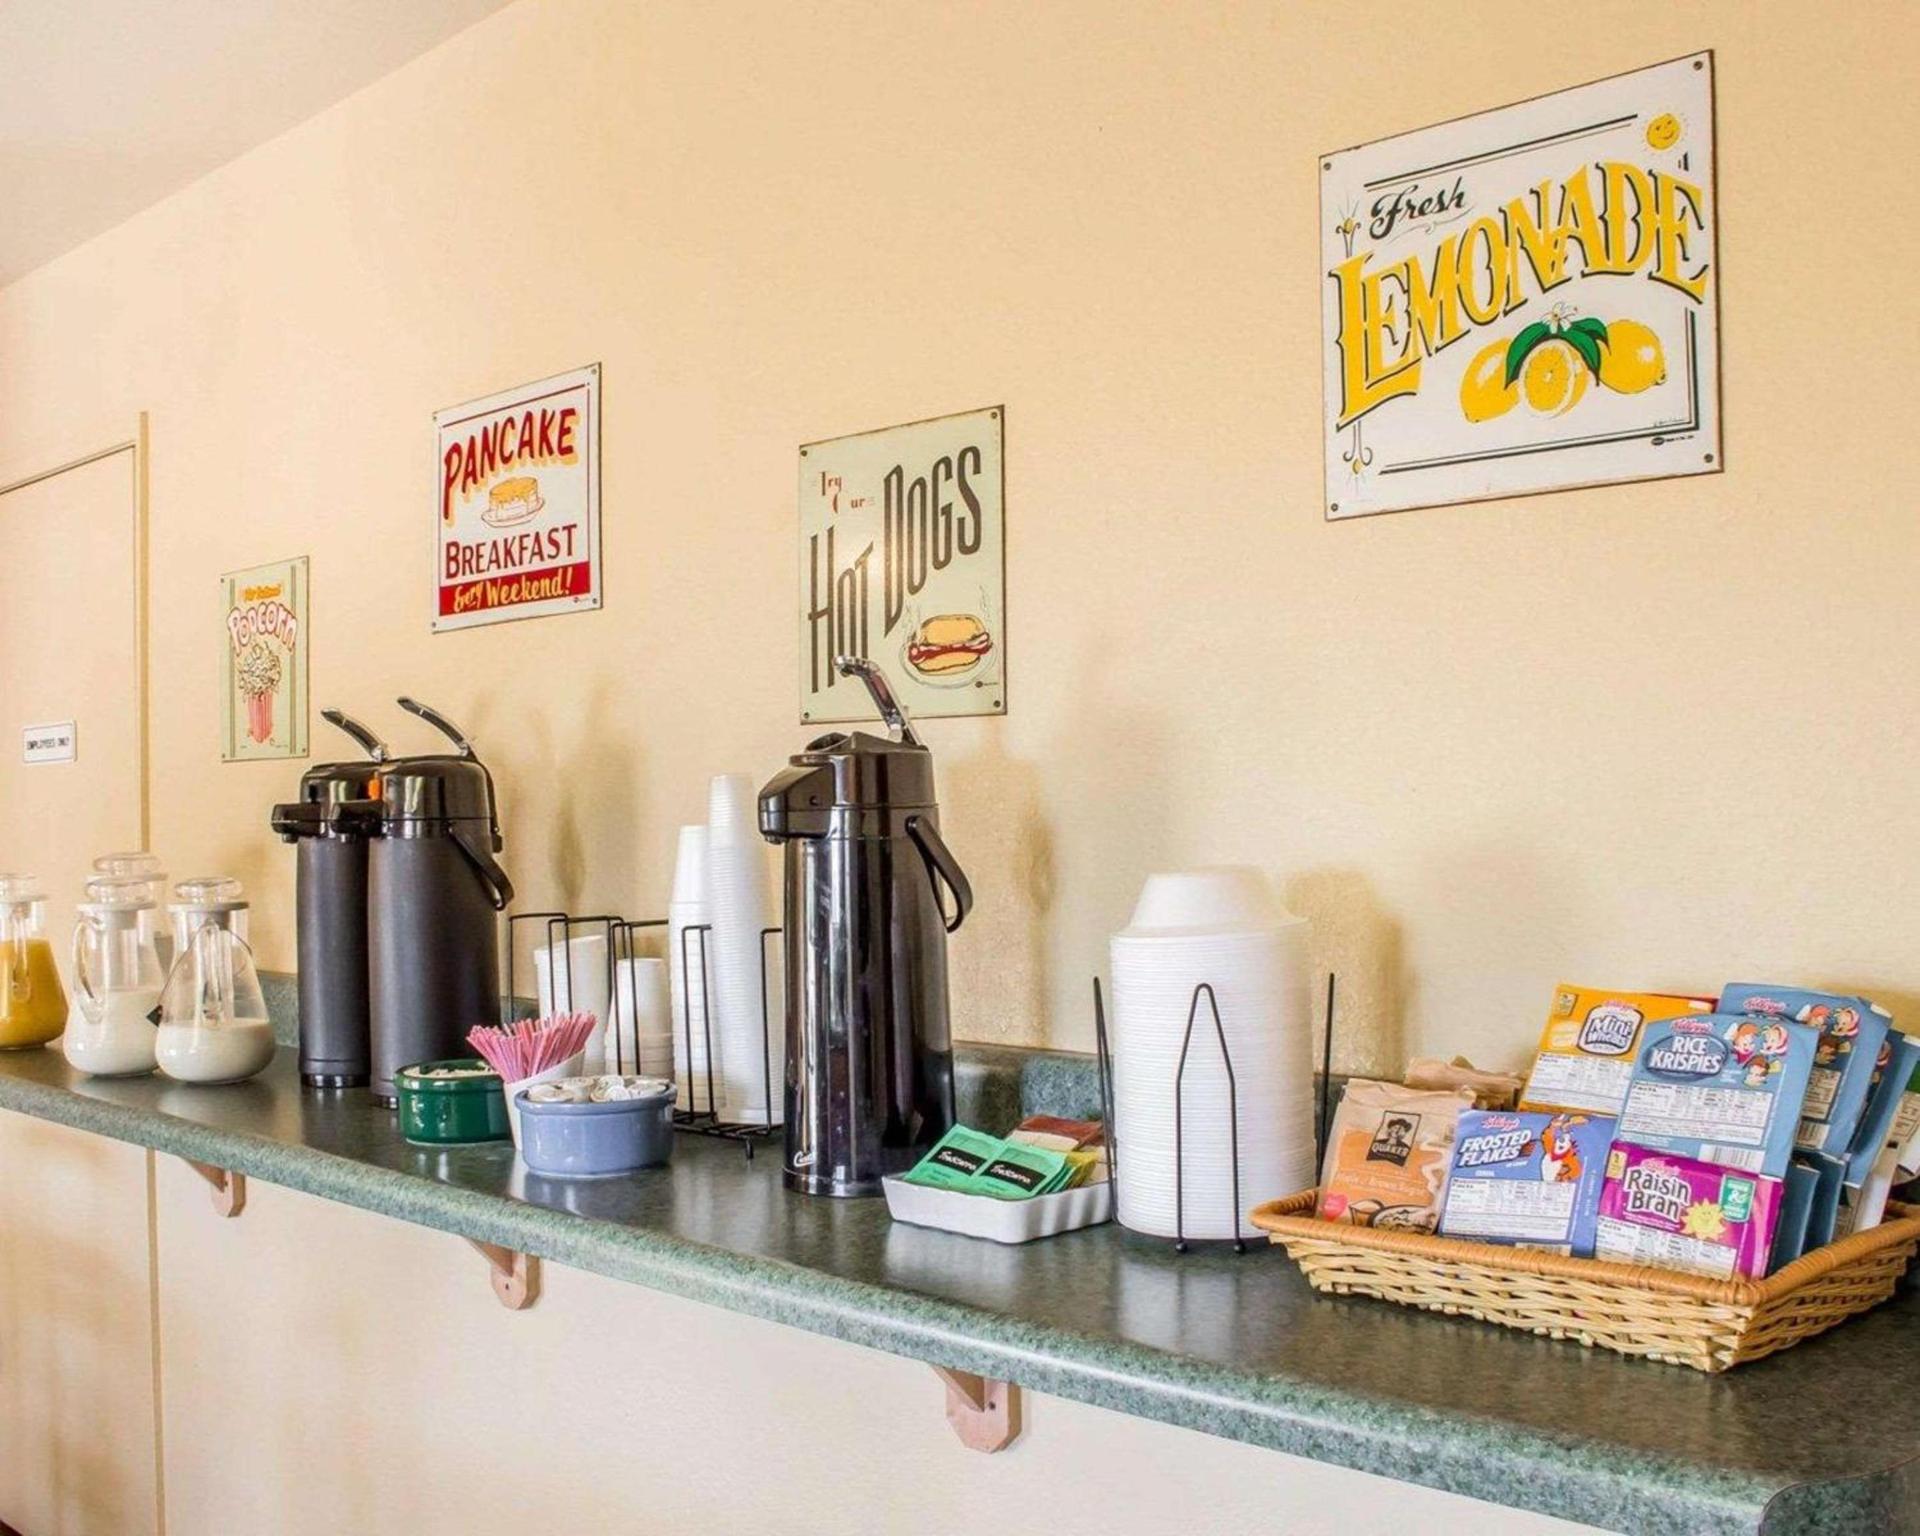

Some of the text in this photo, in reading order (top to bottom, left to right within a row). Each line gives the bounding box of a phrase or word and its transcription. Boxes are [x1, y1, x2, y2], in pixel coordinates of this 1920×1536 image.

[1369, 176, 1468, 241] Fresh
[1328, 160, 1709, 433] LEMONADE
[443, 407, 580, 521] PANCAKE
[445, 523, 577, 580] BREAKFAST
[883, 445, 982, 638] DOGS
[486, 566, 574, 607] Weekend!
[1672, 1036, 1708, 1054] RICE
[1650, 1051, 1723, 1075] KRISPIES
[1371, 1142, 1409, 1157] QUAKER
[1457, 1144, 1522, 1168] FLAKES
[1459, 1129, 1533, 1154] FROSTED
[1628, 1168, 1689, 1202] Raisin
[1631, 1190, 1680, 1220] Bran
